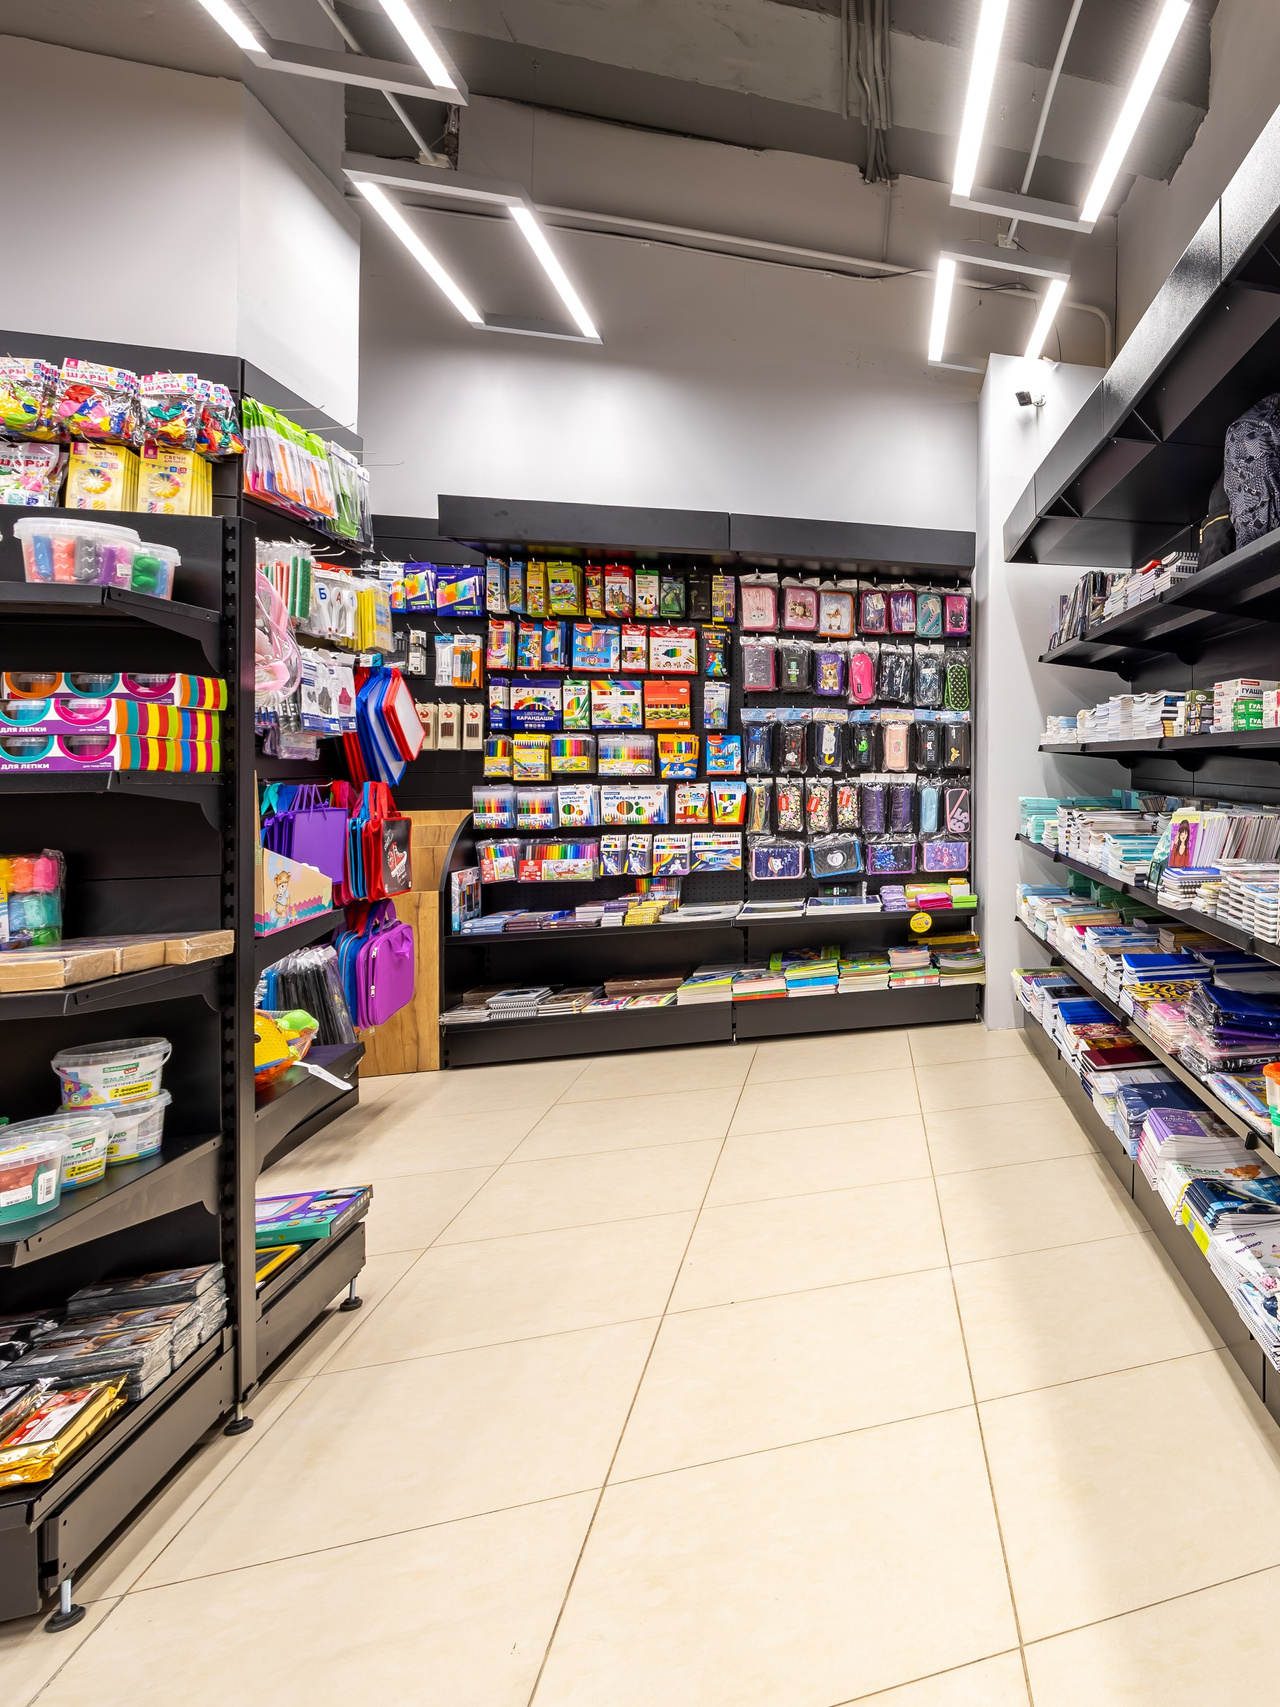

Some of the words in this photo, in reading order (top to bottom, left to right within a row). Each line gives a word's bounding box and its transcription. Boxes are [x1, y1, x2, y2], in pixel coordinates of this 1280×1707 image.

[66, 371, 109, 382] ШАРЫ
[144, 382, 180, 392] ШАРЫ
[318, 588, 326, 600] Б
[336, 592, 341, 604] А
